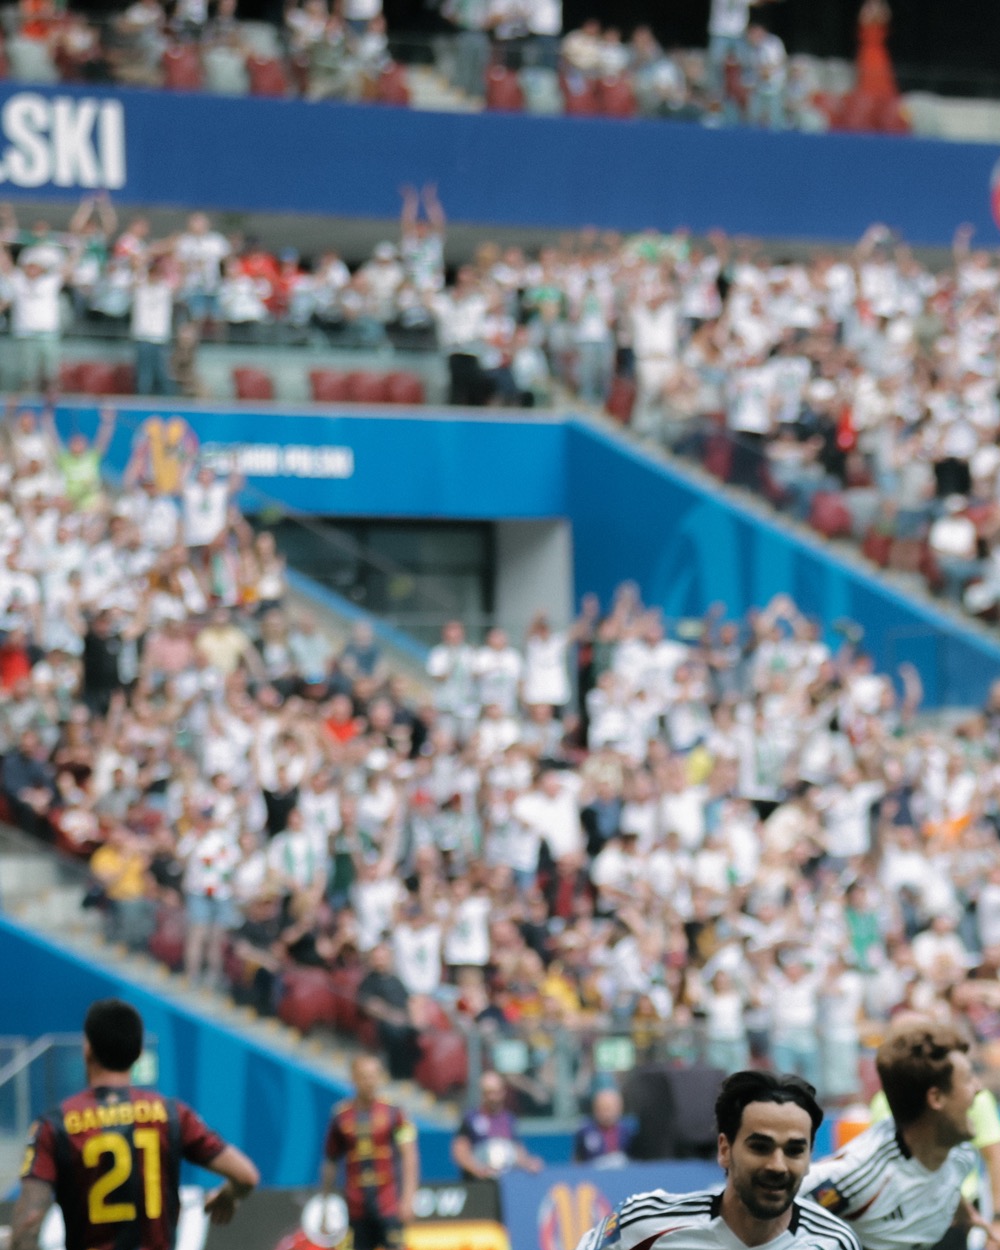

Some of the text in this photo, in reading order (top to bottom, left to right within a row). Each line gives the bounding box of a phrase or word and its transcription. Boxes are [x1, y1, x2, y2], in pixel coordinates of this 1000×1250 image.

[0, 91, 127, 190] SKI
[63, 1099, 169, 1136] GAMBOA
[82, 1127, 163, 1225] 21
